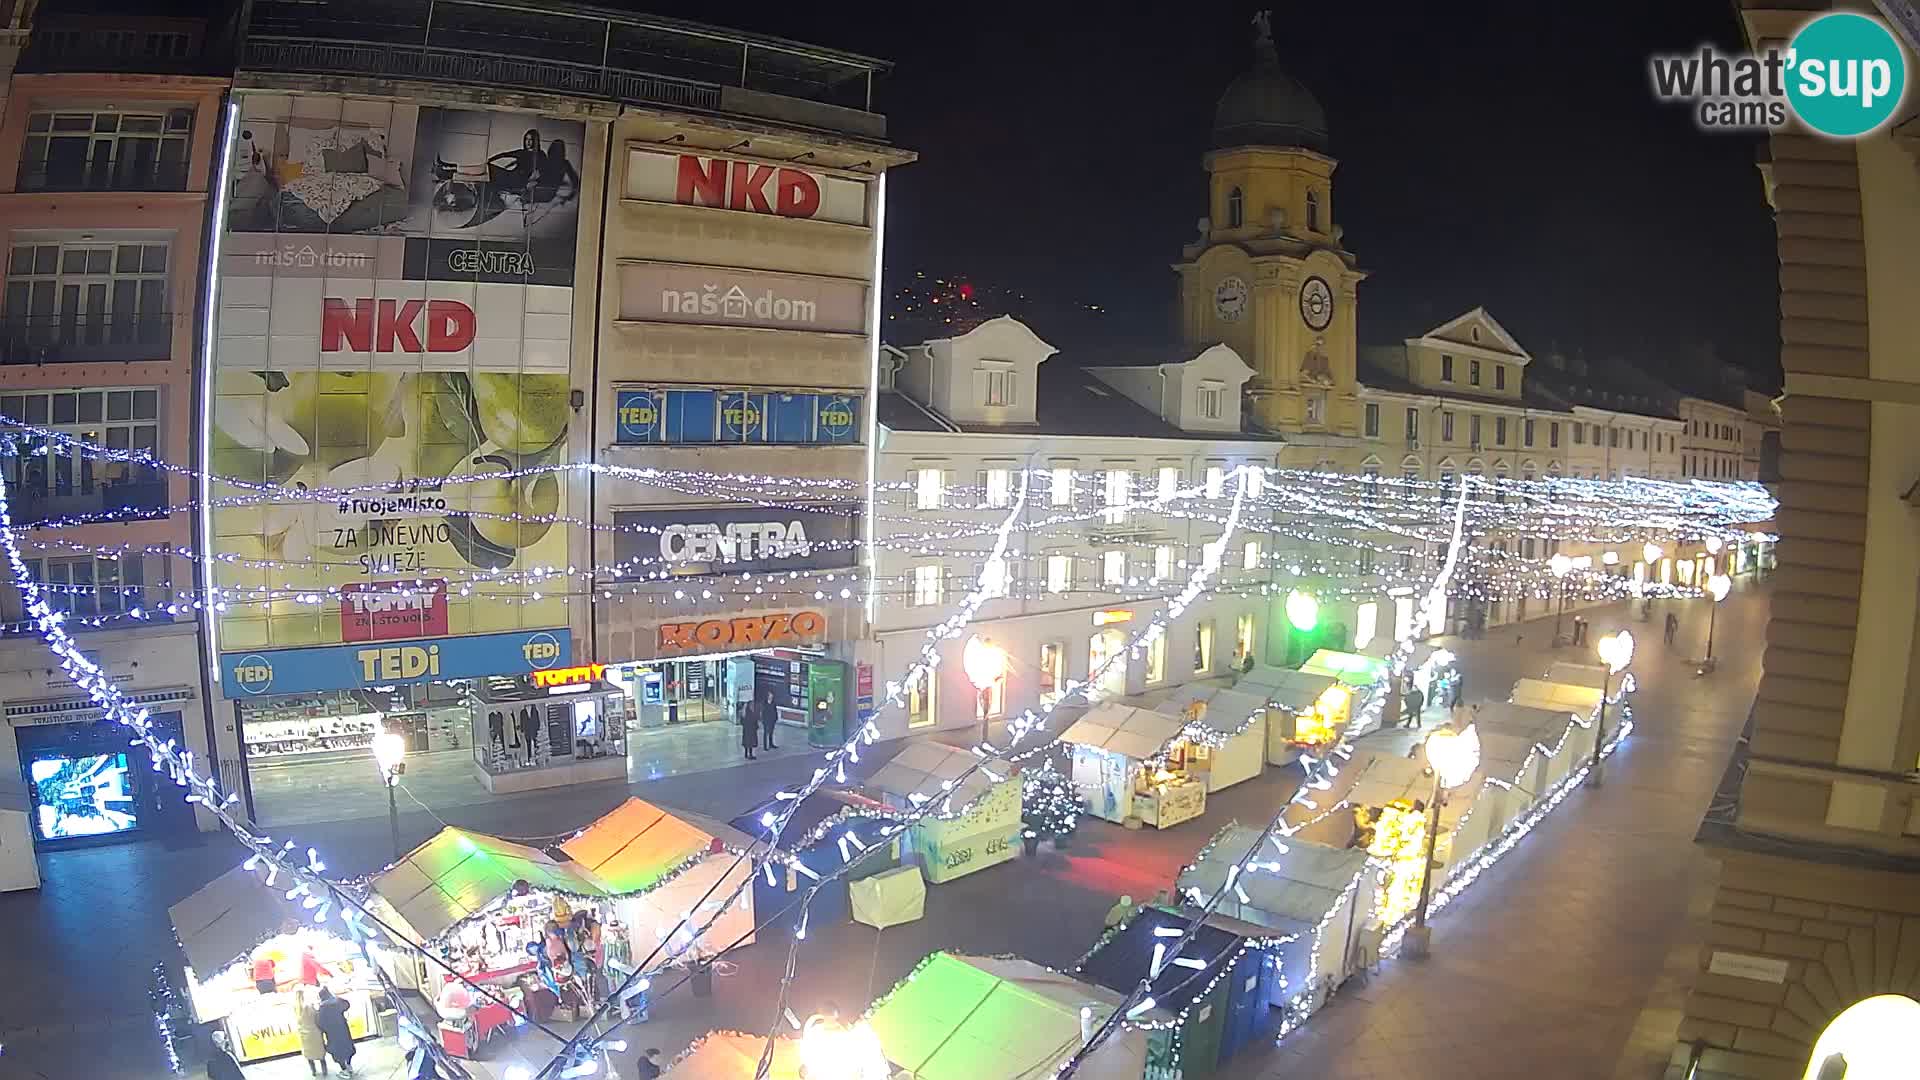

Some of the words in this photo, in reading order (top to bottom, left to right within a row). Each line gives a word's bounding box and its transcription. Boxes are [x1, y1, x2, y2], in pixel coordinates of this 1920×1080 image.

[676, 155, 821, 219] NKD
[254, 244, 295, 266] naš
[320, 246, 366, 269] dom
[447, 249, 536, 275] CENTRA
[661, 282, 719, 315] naš
[754, 289, 817, 323] dom
[321, 297, 478, 354] NKD
[619, 407, 658, 426] TEDi
[820, 411, 854, 427] TEDi
[333, 528, 358, 548] ZA
[368, 522, 451, 547] DNEVNO
[659, 520, 811, 563] CENTRA
[659, 611, 826, 650] KORZO
[357, 645, 441, 682] TEDi
[522, 642, 561, 660] TEDi
[234, 664, 274, 684] TEDi
